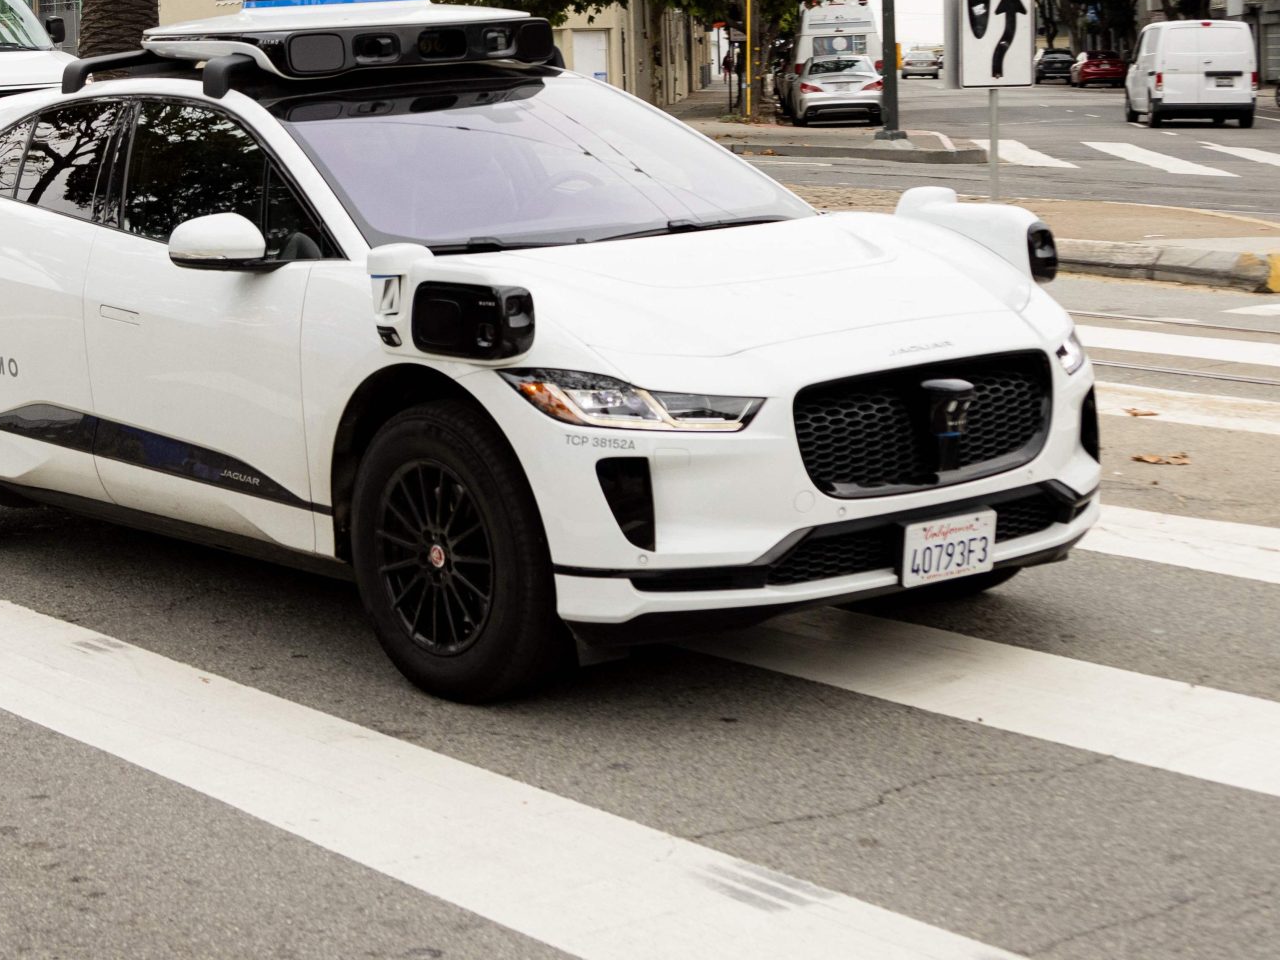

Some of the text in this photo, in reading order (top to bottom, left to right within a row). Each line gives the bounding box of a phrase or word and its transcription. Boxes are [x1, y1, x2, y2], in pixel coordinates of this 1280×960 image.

[565, 434, 636, 450] TCP 38152A
[220, 469, 261, 486] JAGUAR
[910, 536, 989, 576] 40793F3
